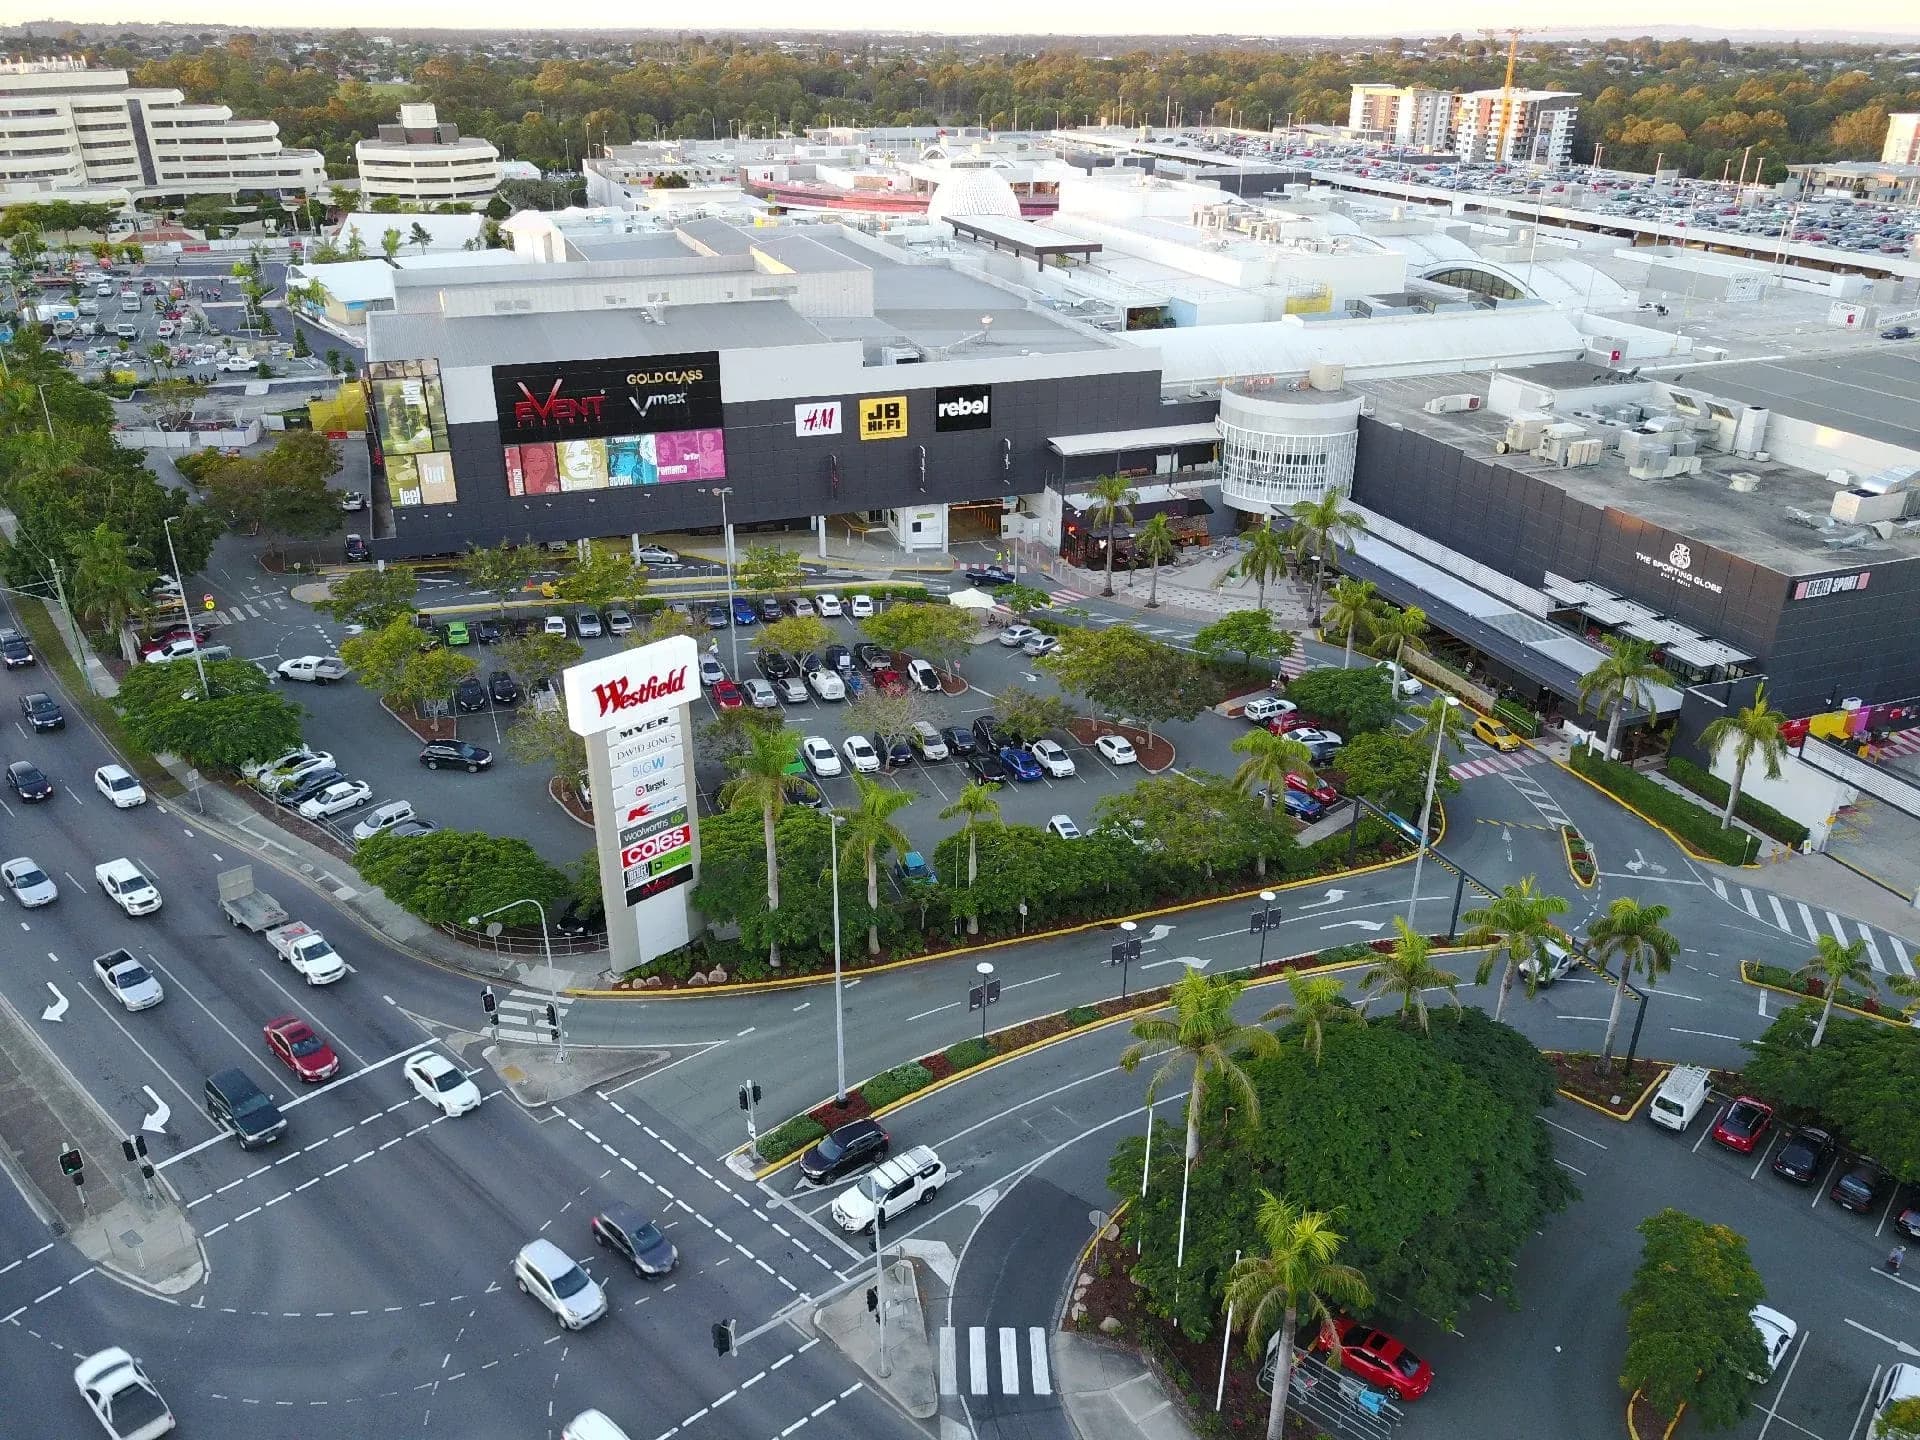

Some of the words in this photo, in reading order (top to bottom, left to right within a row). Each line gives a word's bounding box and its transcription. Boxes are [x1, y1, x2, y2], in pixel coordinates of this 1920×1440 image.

[627, 372, 664, 385] GOLD
[665, 369, 703, 384] CLASS
[515, 378, 606, 419] EVENT
[629, 392, 688, 417] Vmax
[938, 396, 989, 417] rebel
[804, 407, 835, 429] H&M
[867, 403, 900, 420] JB
[657, 464, 688, 476] romance
[399, 487, 421, 505] feel
[1635, 551, 1652, 565] THE
[1652, 559, 1693, 581] SPORTING
[1693, 576, 1723, 594] GLOBE
[1831, 575, 1859, 593] SPORT
[592, 664, 688, 718] Westfield
[619, 716, 669, 739] MYER
[617, 744, 645, 761] DAVID
[646, 732, 676, 750] JONES
[627, 828, 685, 863] coles
